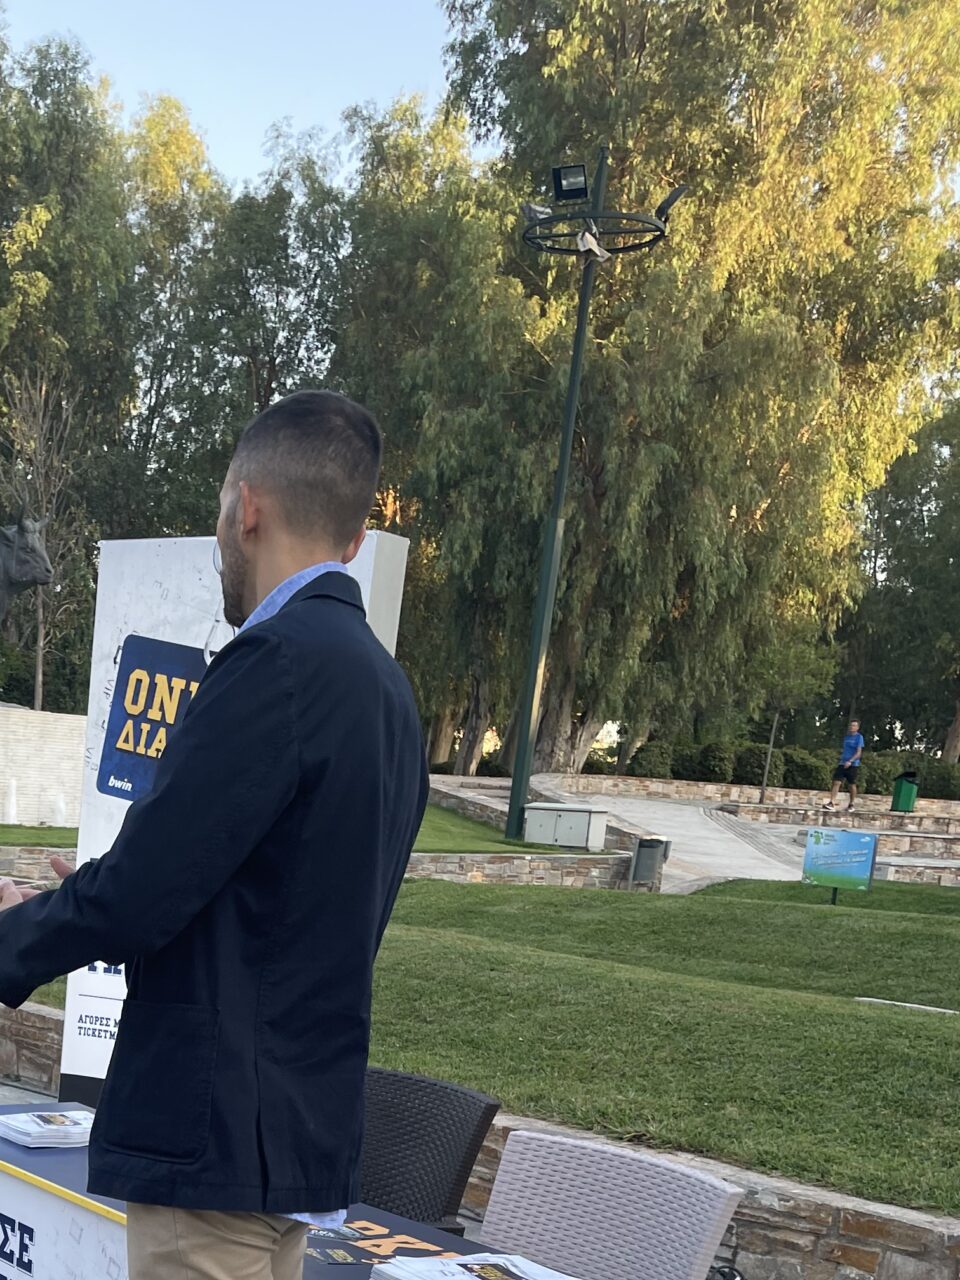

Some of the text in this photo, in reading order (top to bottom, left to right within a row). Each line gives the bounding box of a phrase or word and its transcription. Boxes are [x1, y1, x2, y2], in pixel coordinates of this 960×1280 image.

[123, 668, 200, 725] ΟΝ
[115, 719, 167, 759] ΔΙΑ
[108, 775, 133, 792] bwin
[77, 1013, 111, 1027] ΑΓΟΡΕΣ
[77, 1026, 117, 1040] TICKETM
